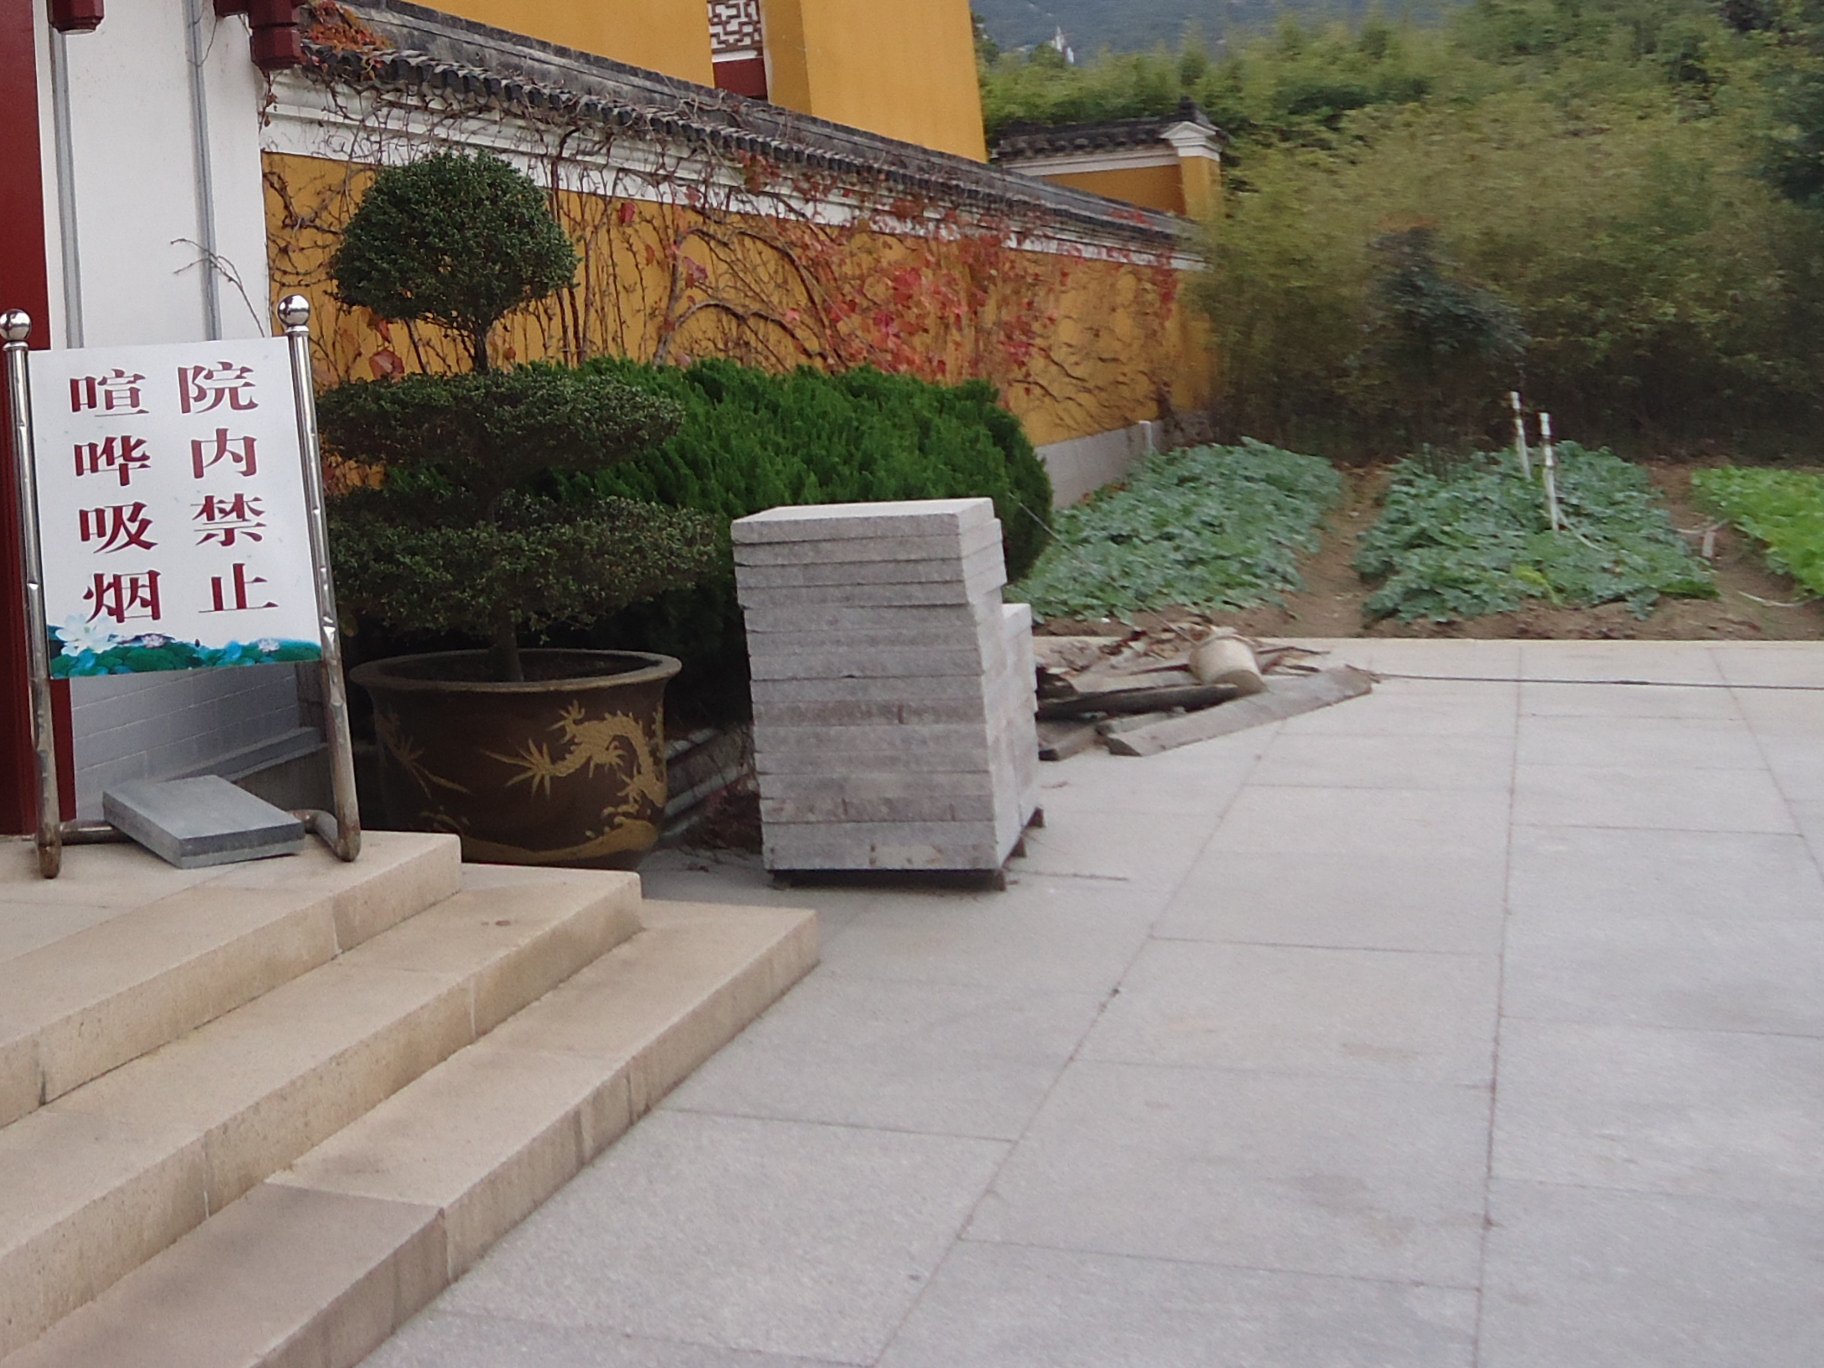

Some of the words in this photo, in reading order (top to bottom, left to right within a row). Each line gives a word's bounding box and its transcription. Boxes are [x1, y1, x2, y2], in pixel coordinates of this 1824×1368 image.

[69, 368, 162, 624] 喧哗吸烟
[177, 361, 279, 614] 院内禁止
